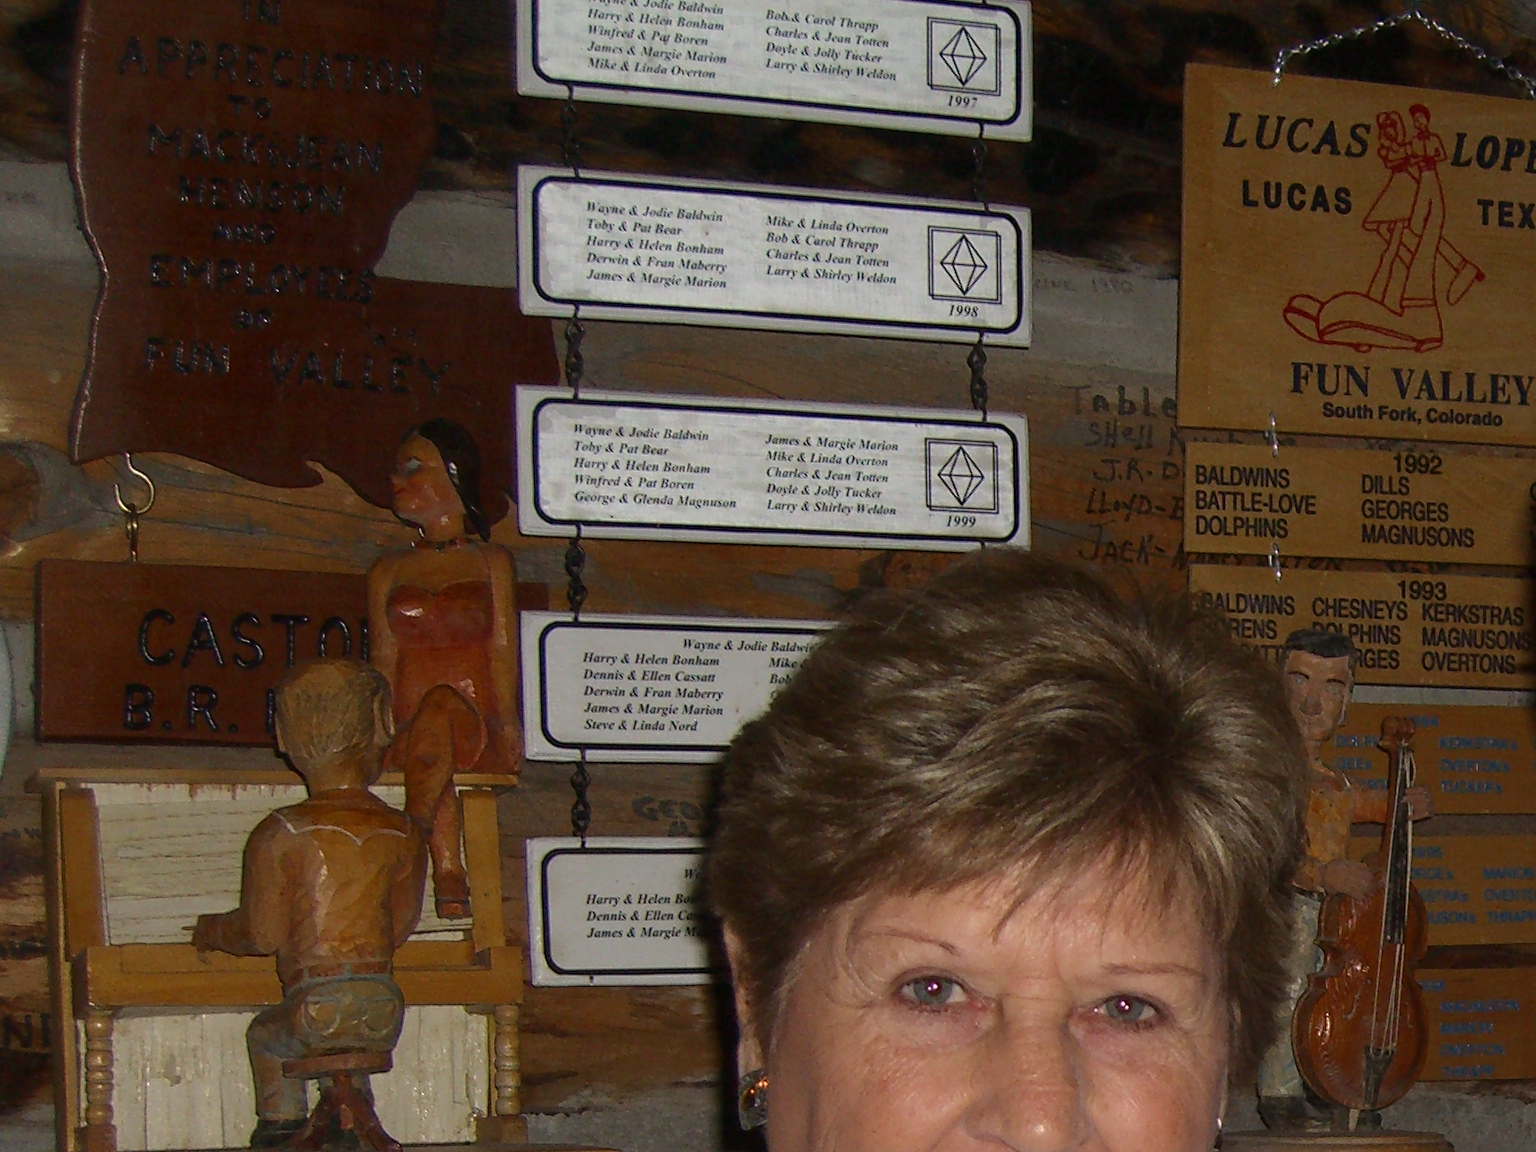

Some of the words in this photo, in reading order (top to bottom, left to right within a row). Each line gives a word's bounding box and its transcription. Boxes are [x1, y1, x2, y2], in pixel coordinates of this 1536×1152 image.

[119, 36, 423, 96] APPRECIATION
[948, 95, 977, 108] 1997
[1223, 112, 1371, 157] LUCAS
[180, 174, 346, 215] HENSON
[1242, 179, 1352, 215] LUCAS
[151, 254, 376, 303] EMPLOYEES
[949, 305, 980, 317] 1998
[146, 336, 230, 375] FUN
[269, 347, 450, 394] VALLEY
[1290, 362, 1371, 397] FUN
[1392, 368, 1535, 406] VALLEY
[1322, 401, 1374, 421] South
[1378, 404, 1422, 424] Fork,
[1426, 407, 1503, 427] Colorado
[574, 424, 612, 437] Wayne
[615, 426, 624, 436] &
[629, 427, 659, 438] Jodie
[663, 429, 708, 440] Baldwin
[765, 434, 799, 445] James
[802, 436, 811, 446] &
[817, 436, 856, 450] Margie
[859, 439, 898, 450] Marion
[575, 440, 602, 454] Toby
[605, 442, 613, 452] &
[619, 443, 638, 453] Pat
[642, 444, 668, 455] Bear
[766, 450, 793, 461] Mike
[797, 452, 805, 462] &
[810, 453, 841, 464] Linda
[845, 455, 888, 466] Overton
[574, 457, 608, 471] Harry
[611, 460, 620, 469] &
[625, 460, 658, 471] Helen
[663, 462, 710, 473] Bonham
[766, 467, 808, 478] Charles
[811, 469, 820, 479] &
[824, 470, 850, 480] Jean
[856, 471, 888, 482] Totten
[1394, 453, 1443, 475] 1992
[575, 474, 620, 488] Winfred
[624, 477, 632, 487] &
[638, 477, 657, 487] Pat
[660, 478, 694, 489] Boren
[766, 483, 798, 496] Doyle
[801, 485, 809, 495] &
[814, 486, 841, 499] Jolly
[845, 486, 882, 498] Tucker
[1195, 465, 1290, 489] BALDWINS
[1362, 474, 1410, 496] DILLS
[574, 491, 615, 505] George
[618, 493, 628, 503] &
[633, 493, 673, 505] Glenda
[678, 495, 736, 509] Magnuson
[767, 499, 797, 513] Larry
[801, 501, 809, 511] &
[813, 502, 853, 515] Shirley
[857, 503, 896, 515] Weldon
[1195, 490, 1317, 515] BATTLE-LOVE
[1362, 499, 1449, 522] GEORGES
[945, 514, 976, 528] 1999
[1195, 515, 1288, 538] DOLPHINS
[1362, 524, 1474, 548] MAGNUSONS
[1398, 580, 1447, 602] 1993
[1312, 597, 1408, 621] CHESNEYS
[1422, 602, 1525, 627] KERKSTRAS
[1422, 628, 1532, 651] MAGNUSONS
[583, 652, 617, 665] Harry
[620, 653, 629, 663] &
[635, 653, 667, 664] Helen
[672, 654, 719, 665] Bonham
[1422, 652, 1517, 675] OVERTONS
[583, 669, 624, 680] Dennis
[627, 670, 636, 680] &
[641, 670, 670, 681] Ellen
[675, 671, 715, 682] Cassatt
